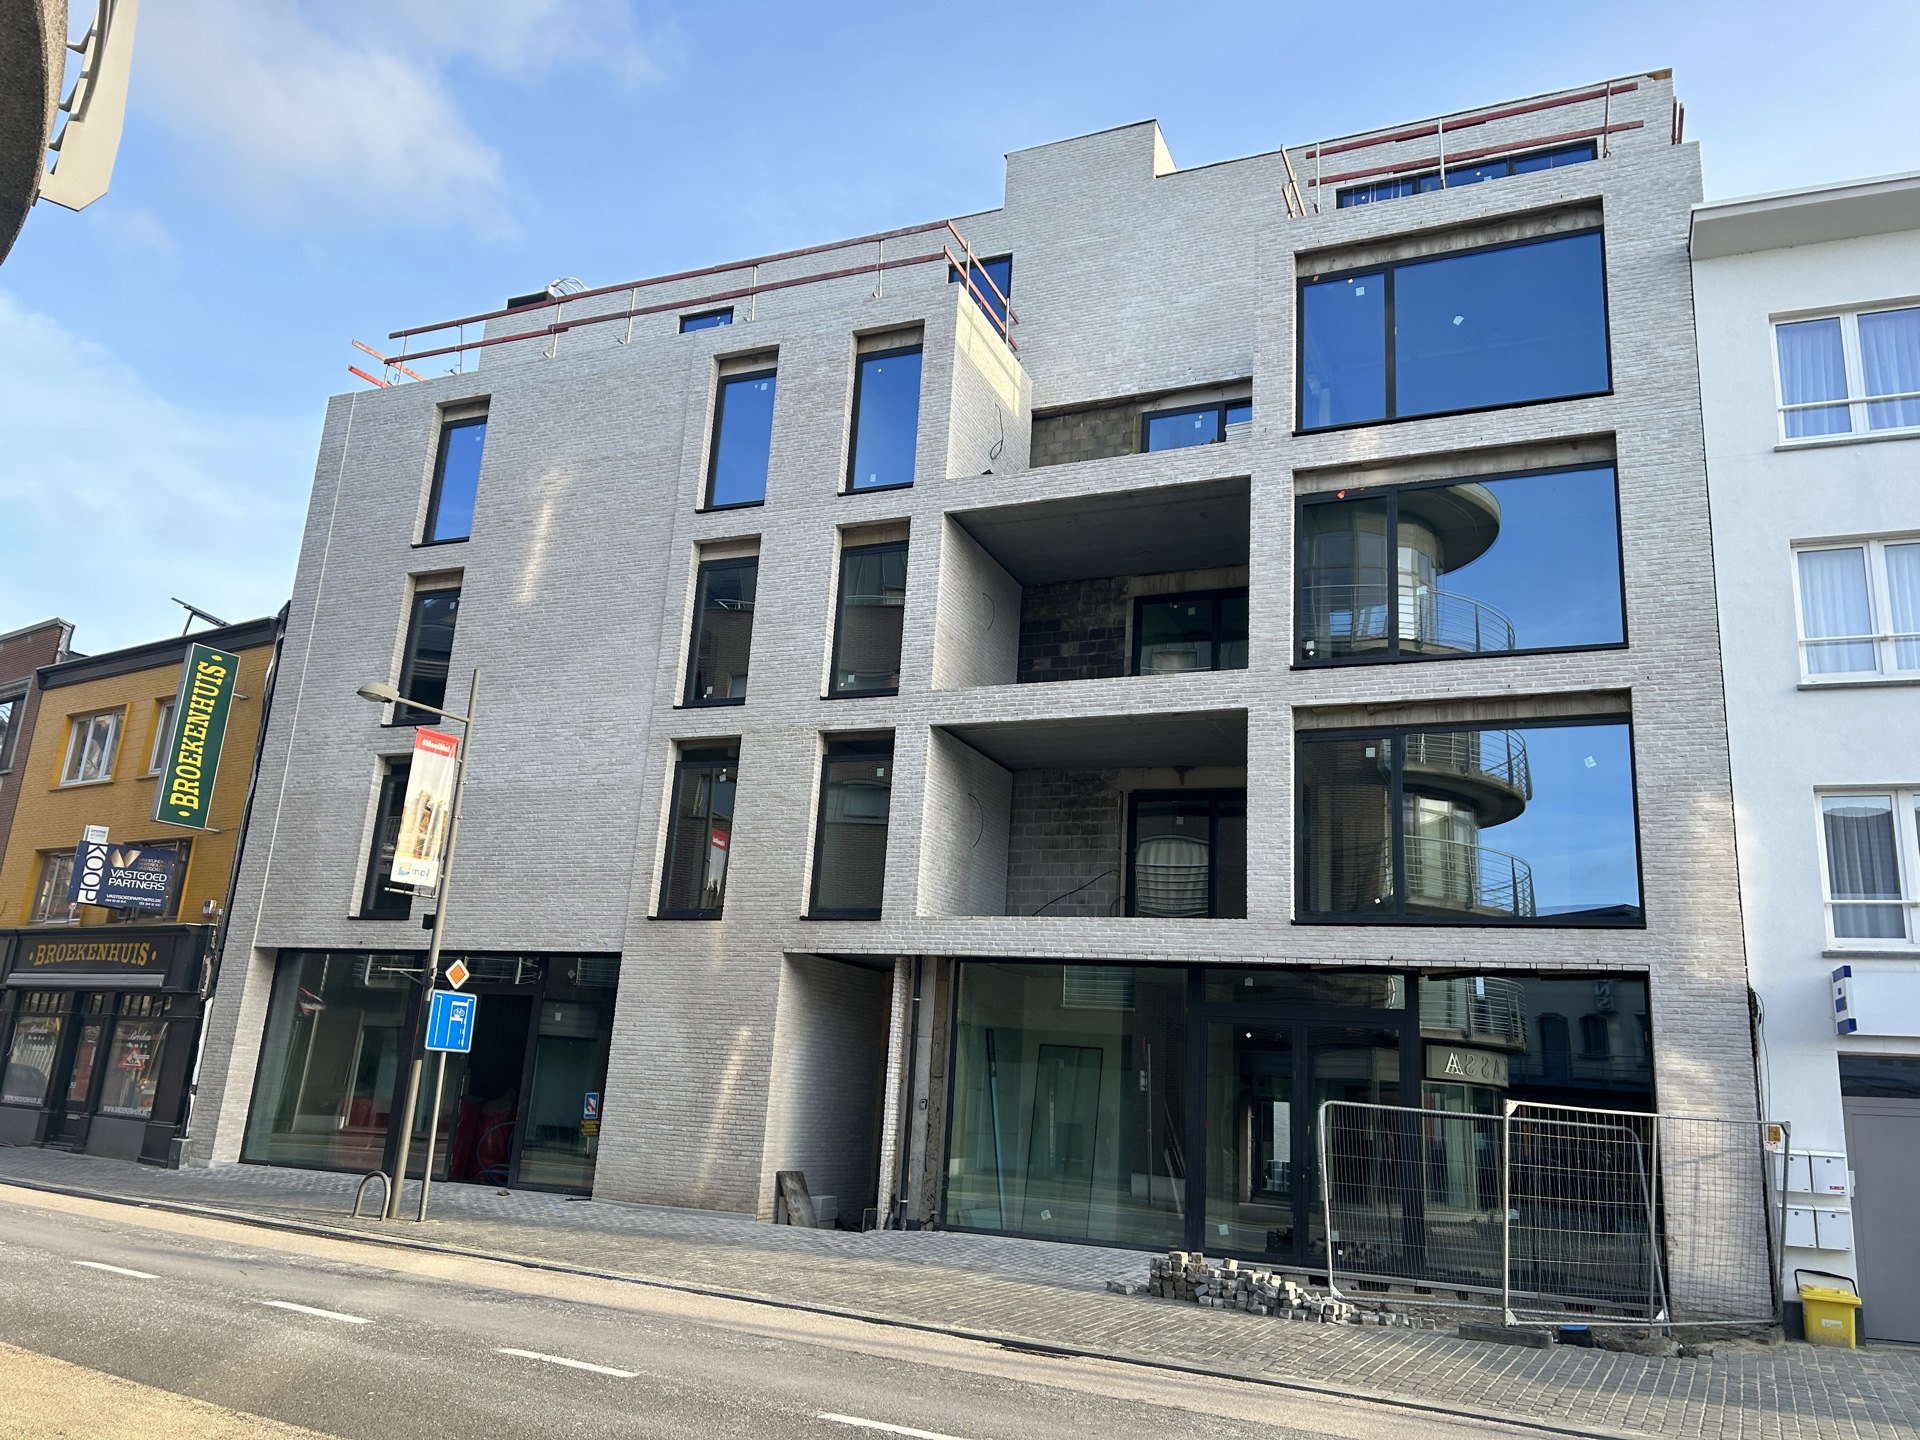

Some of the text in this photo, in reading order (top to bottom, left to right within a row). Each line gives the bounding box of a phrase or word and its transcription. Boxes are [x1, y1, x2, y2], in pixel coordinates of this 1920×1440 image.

[170, 661, 227, 810] BROEKENHUIS
[80, 842, 108, 903] KOOP
[111, 868, 167, 882] VASTGOED
[412, 868, 430, 877] mol
[108, 877, 165, 891] PARTNERS
[34, 943, 150, 966] BROEKENHUIS
